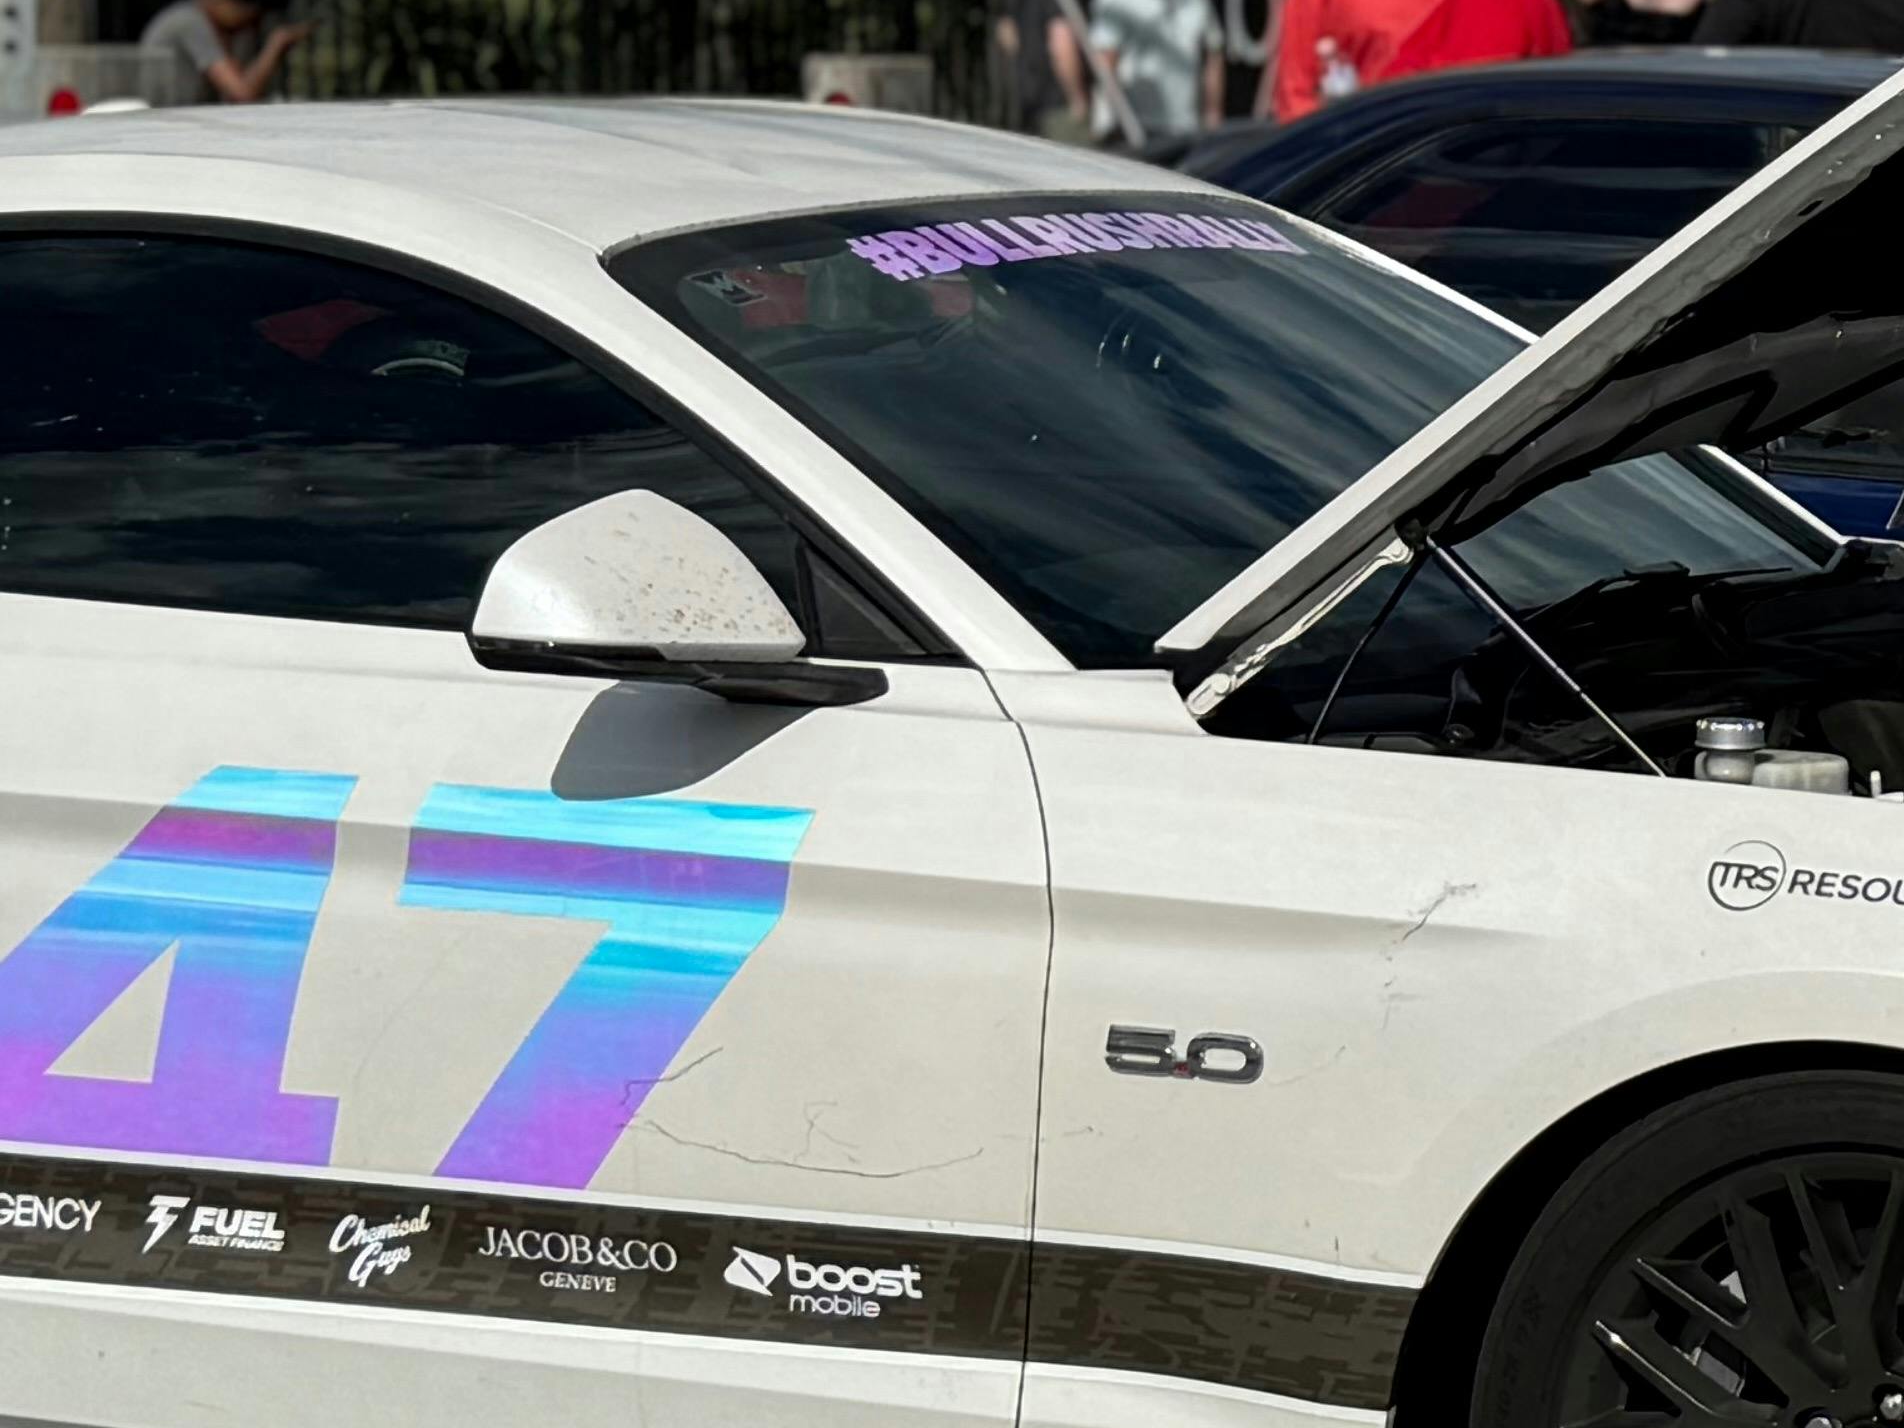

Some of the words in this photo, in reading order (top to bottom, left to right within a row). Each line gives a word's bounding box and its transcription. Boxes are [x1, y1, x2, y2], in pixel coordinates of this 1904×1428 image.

[1709, 861, 1780, 892] TRS
[0, 765, 815, 1190] 47
[1104, 1024, 1265, 1085] 5.0
[189, 1205, 285, 1240] FUEL
[328, 1204, 431, 1253] Chemical
[348, 1242, 411, 1288] Guys
[478, 1226, 678, 1272] JACOB&CO
[540, 1270, 617, 1293] GENEVE
[786, 1254, 924, 1299] boost
[789, 1293, 881, 1317] mobile
